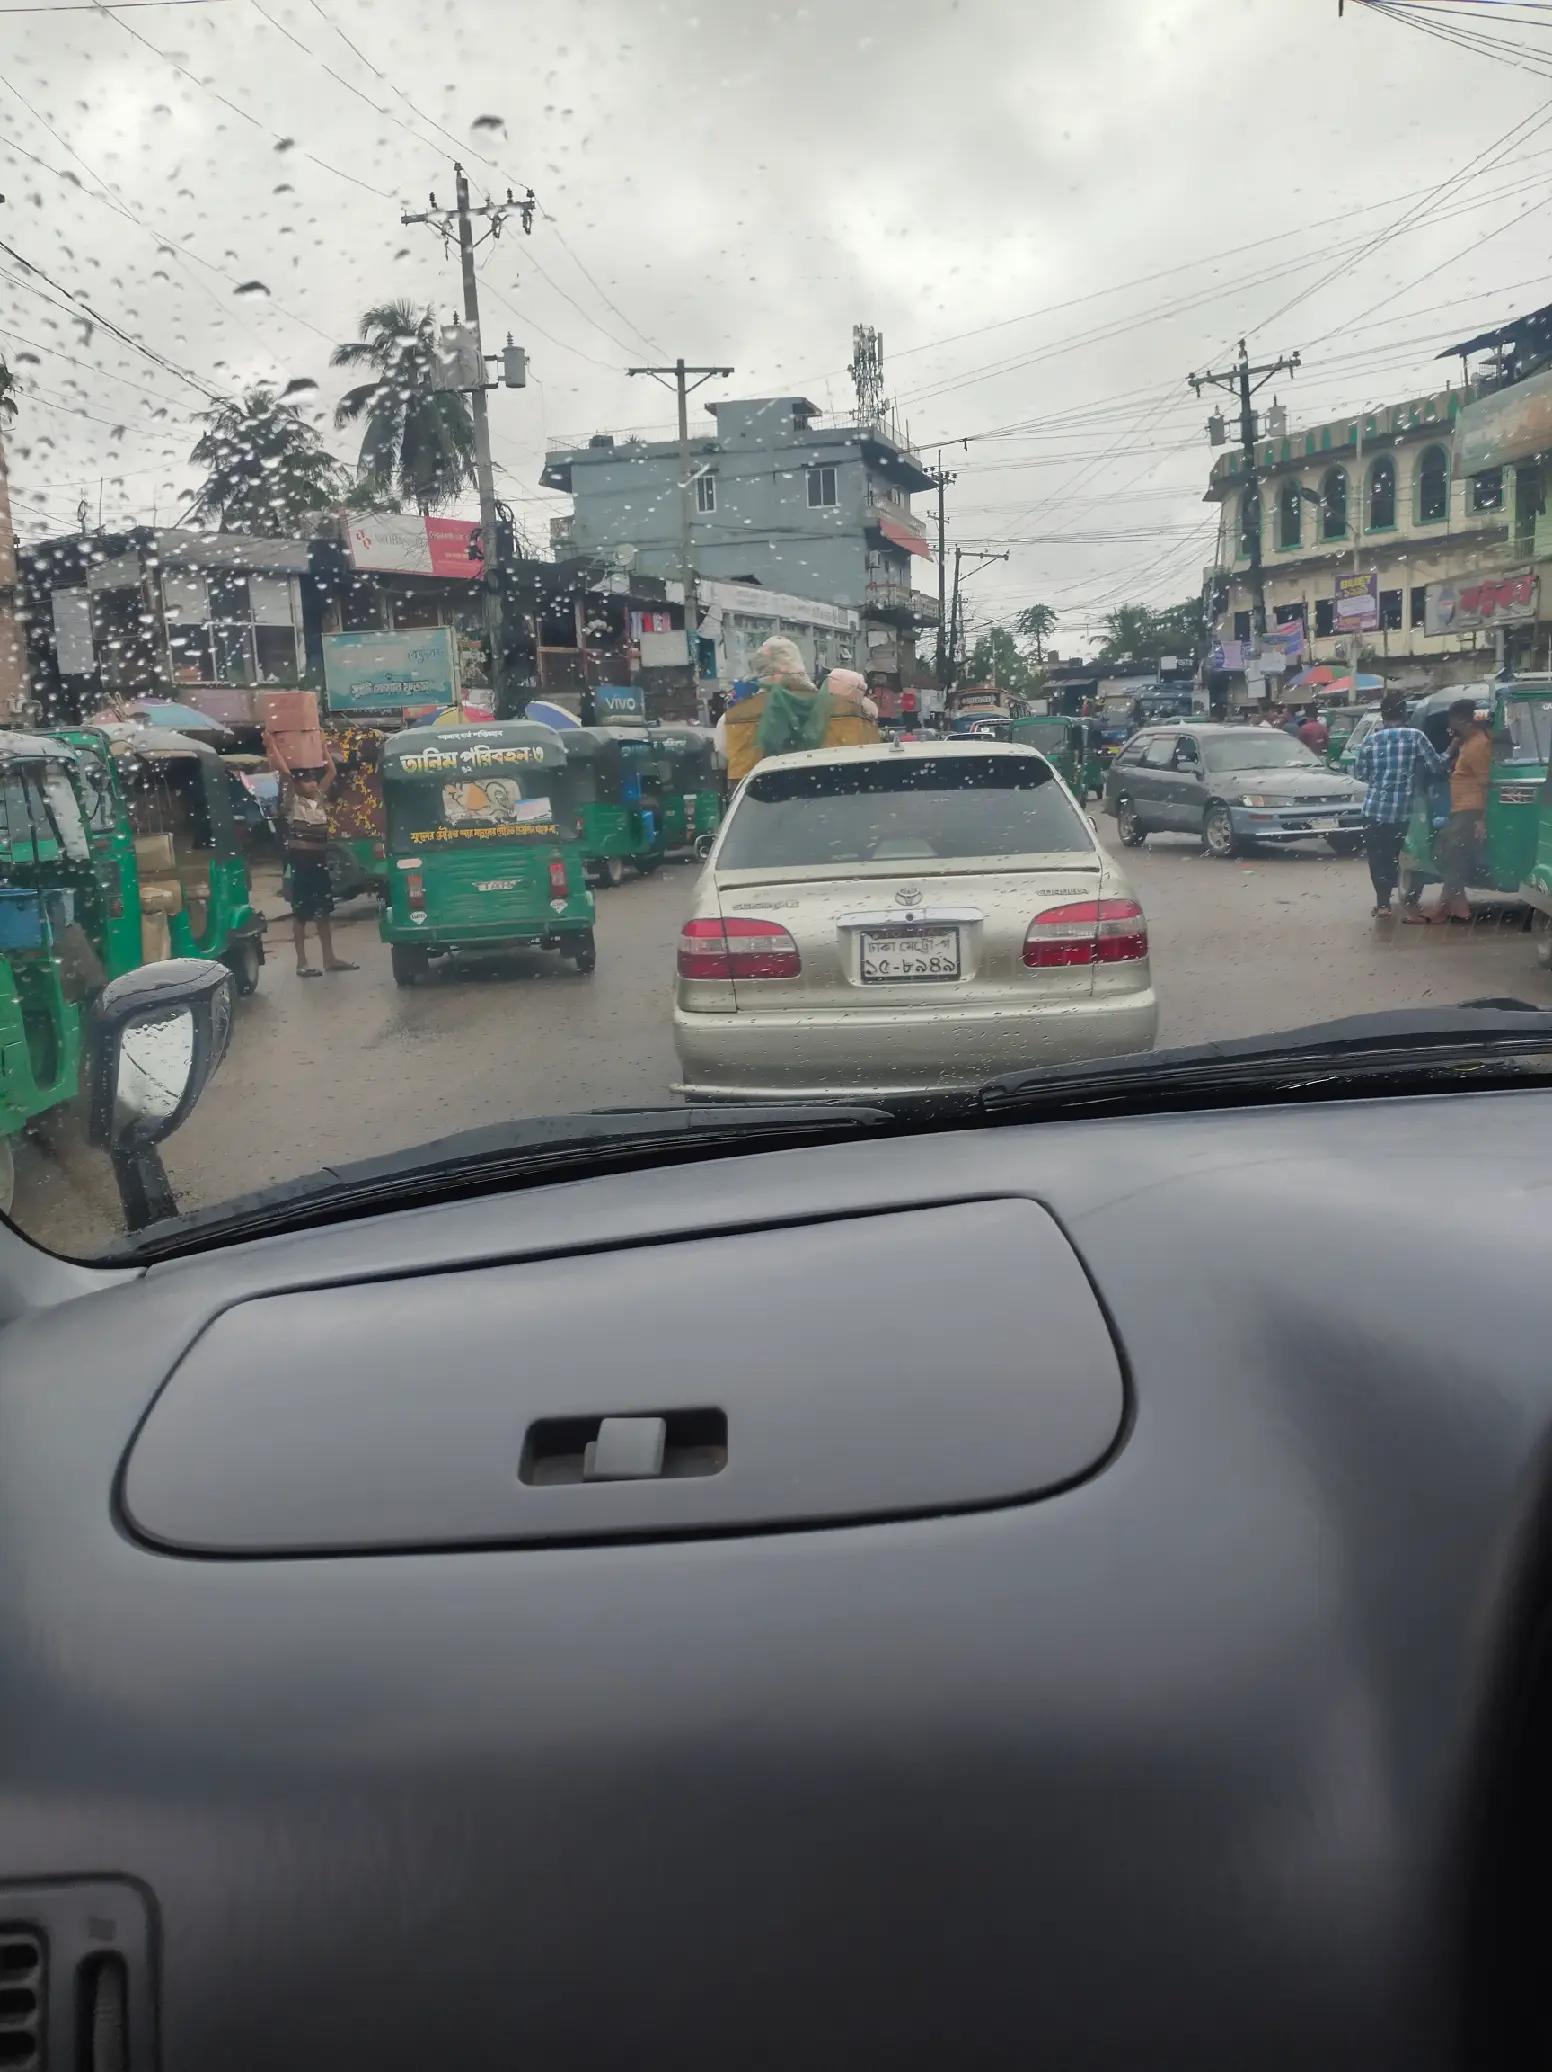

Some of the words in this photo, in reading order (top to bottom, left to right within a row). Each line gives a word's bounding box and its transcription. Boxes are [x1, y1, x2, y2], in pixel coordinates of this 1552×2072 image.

[606, 696, 636, 710] vivo
[400, 747, 458, 773] তানিম
[868, 941, 896, 953] ঢাকা
